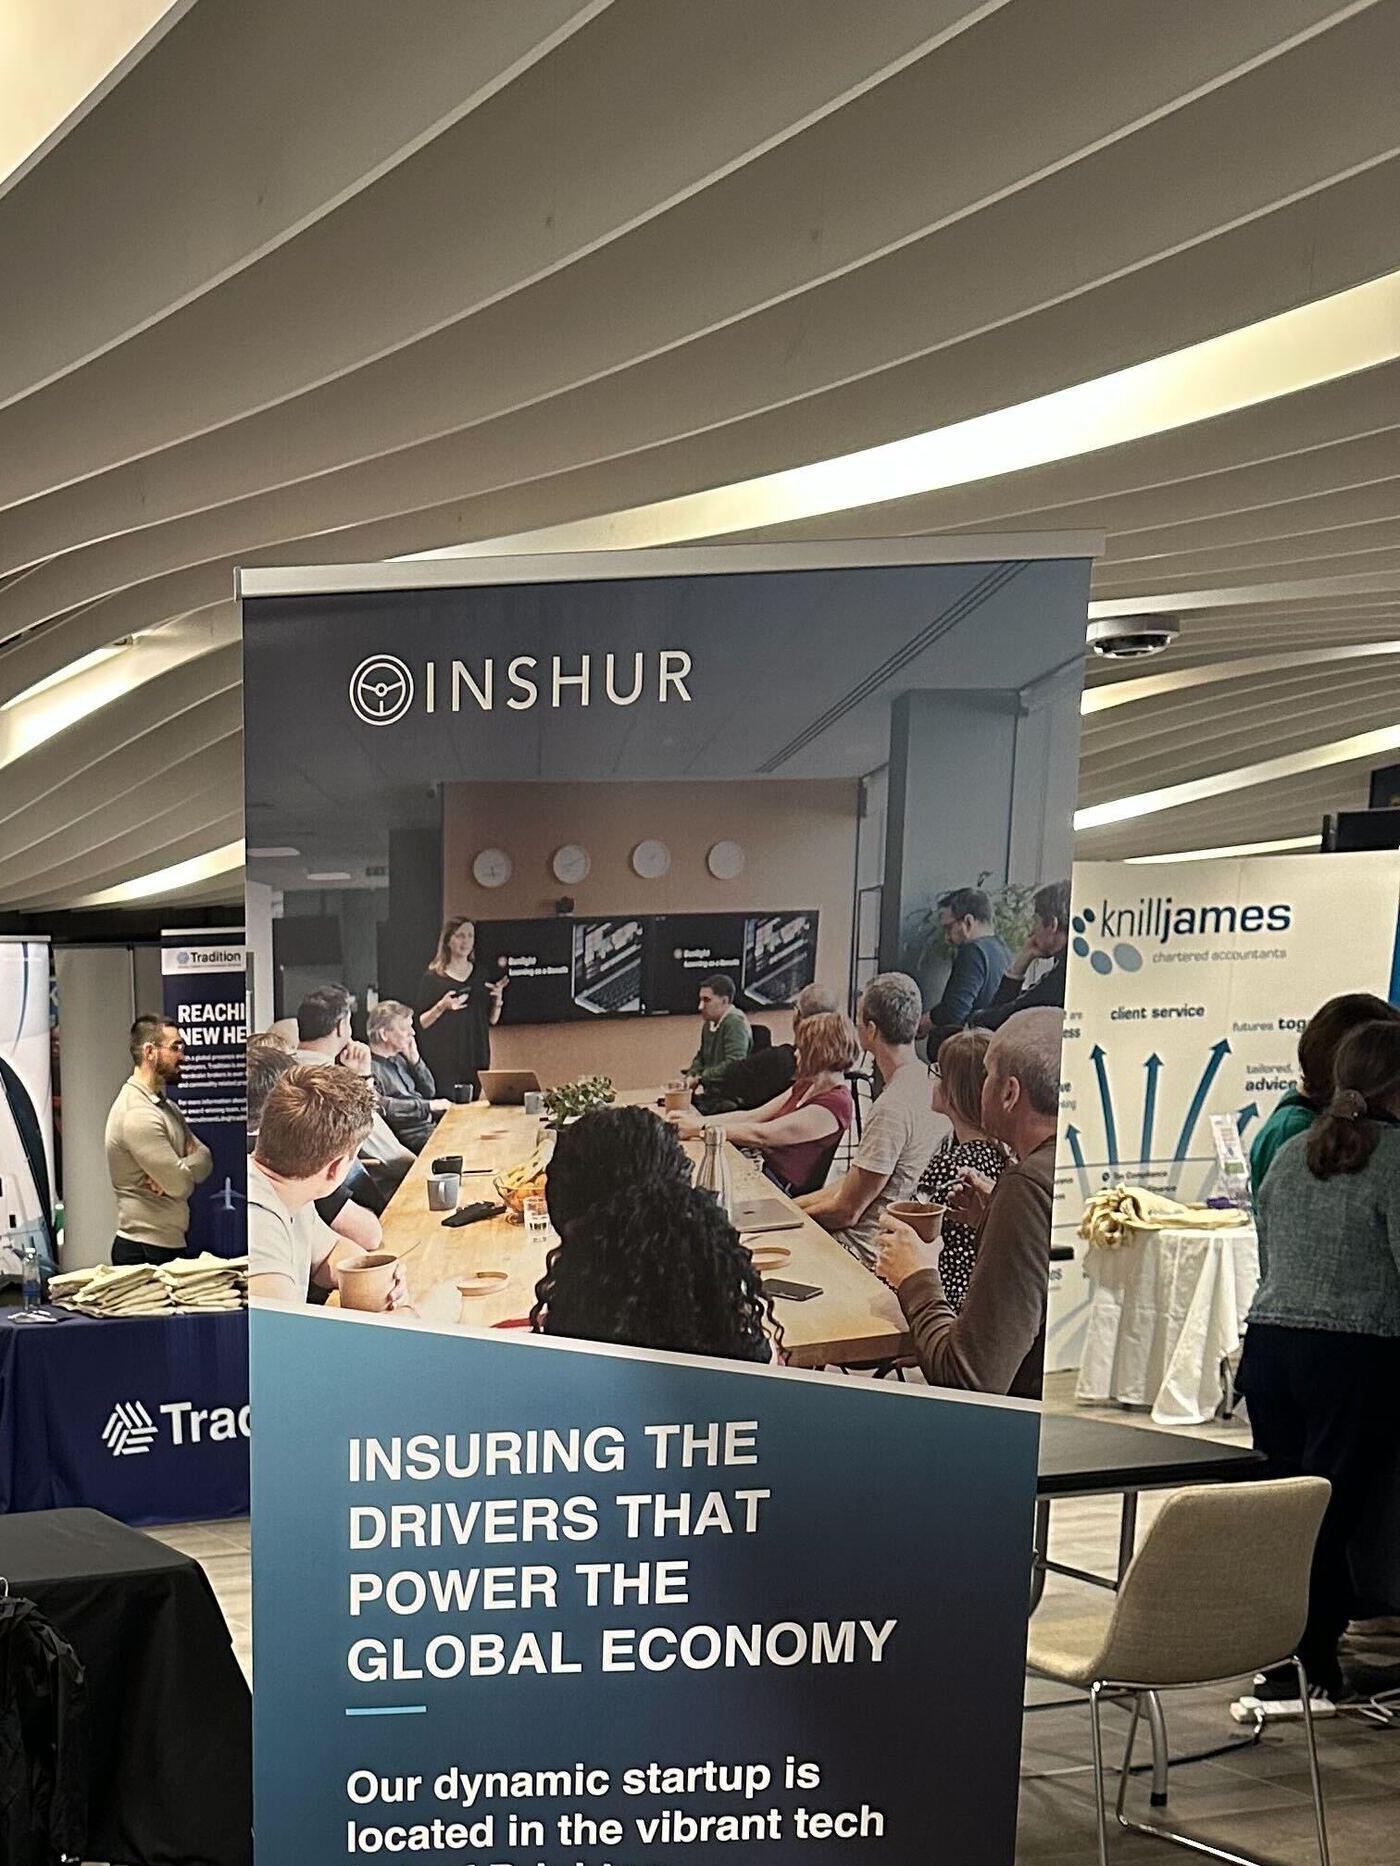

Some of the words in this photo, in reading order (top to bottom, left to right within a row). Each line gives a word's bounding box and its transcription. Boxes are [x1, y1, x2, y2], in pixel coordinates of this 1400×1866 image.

[426, 650, 692, 713] INSHUR
[1101, 898, 1291, 944] knilljames
[190, 951, 241, 963] Tradition
[1152, 950, 1209, 964] chartered
[1211, 948, 1287, 961] accountants
[178, 1027, 221, 1046] NEW
[1110, 1007, 1147, 1021] client
[1151, 1003, 1205, 1019] service
[349, 1426, 625, 1482] INSURING
[644, 1421, 758, 1469] THE
[349, 1495, 598, 1550] DRIVERS
[616, 1489, 771, 1538] THAT
[350, 1565, 557, 1616] POWER
[575, 1560, 689, 1607] THE
[347, 1631, 582, 1682] GLOBAL
[602, 1619, 897, 1672] ECONOMY
[346, 1770, 422, 1804] Our
[433, 1763, 610, 1807] dynamic
[622, 1760, 771, 1796] startup
[785, 1756, 820, 1789] is
[347, 1815, 494, 1853] located
[508, 1814, 544, 1847] in
[557, 1813, 623, 1846] the
[635, 1808, 782, 1844] vibrant
[793, 1804, 884, 1839] tech
